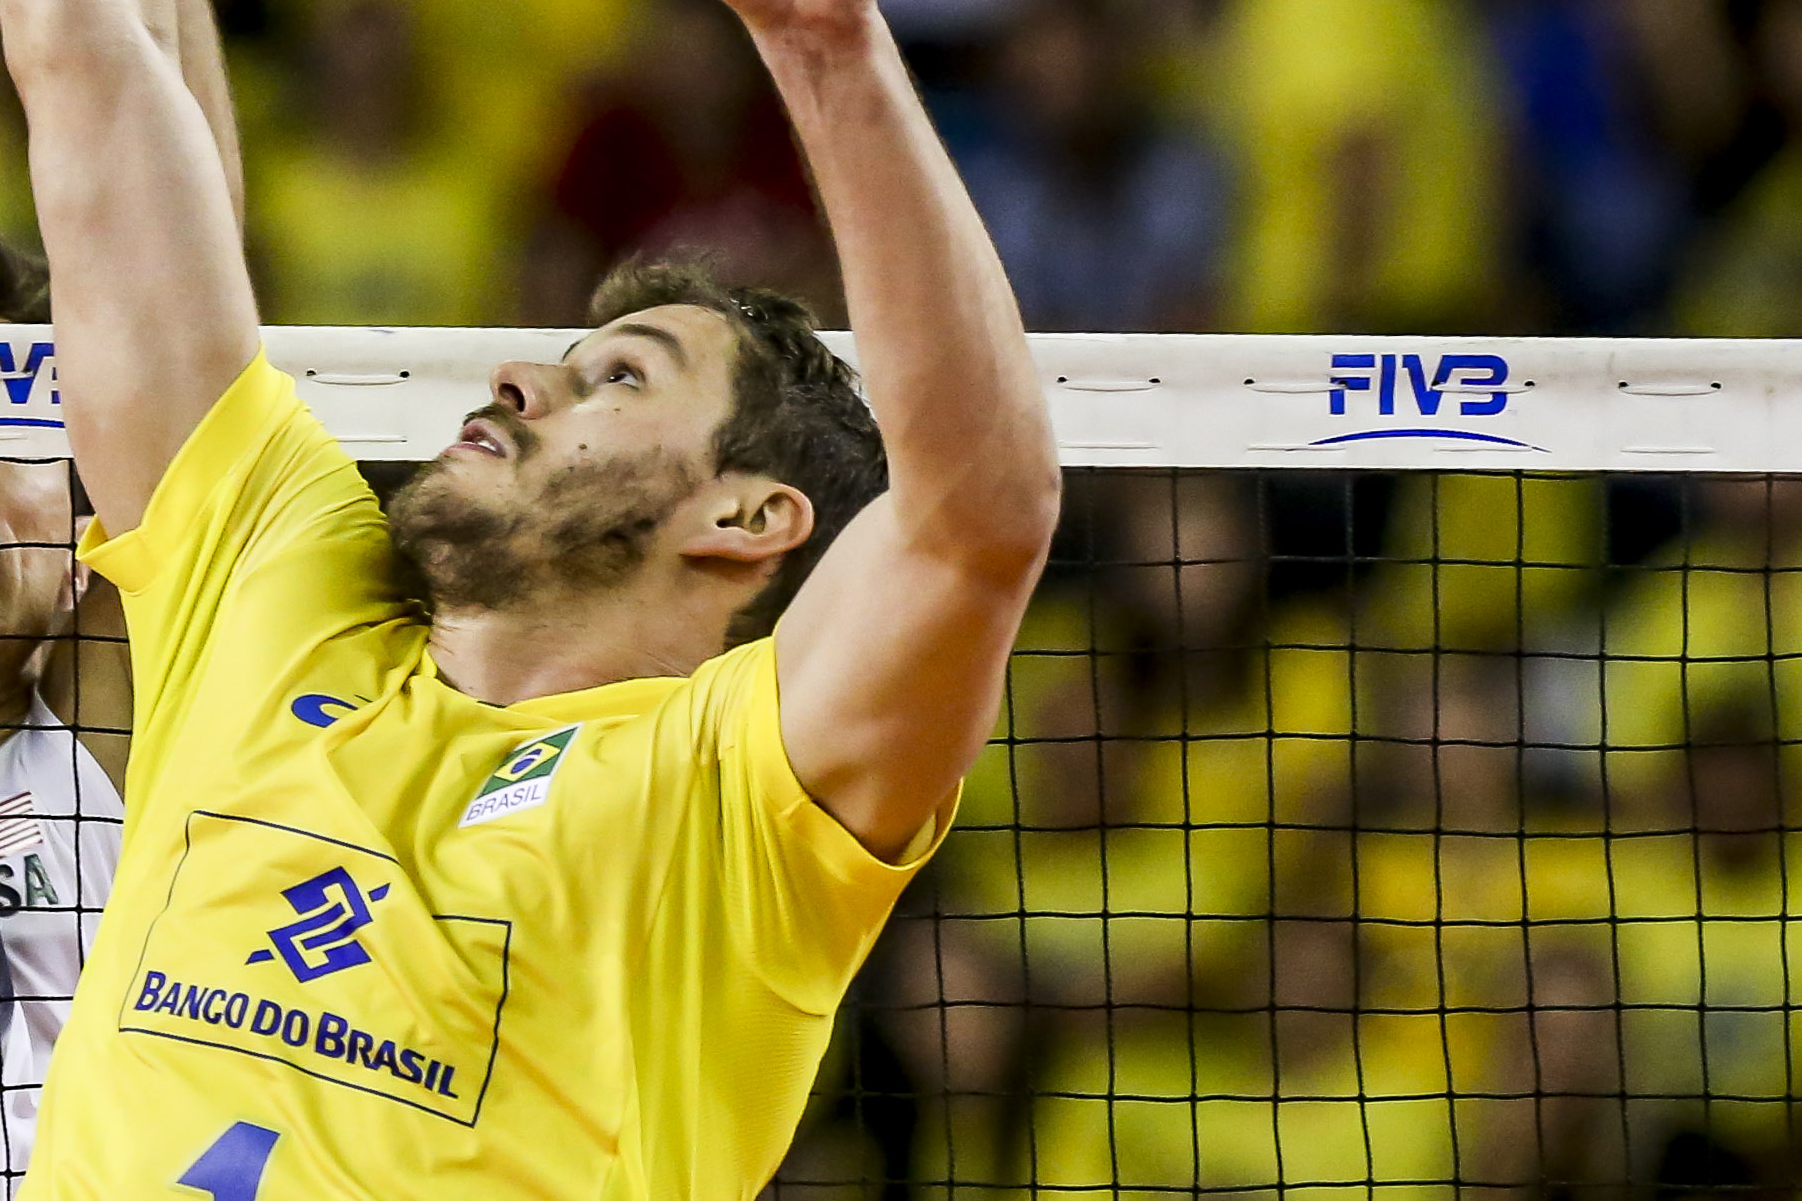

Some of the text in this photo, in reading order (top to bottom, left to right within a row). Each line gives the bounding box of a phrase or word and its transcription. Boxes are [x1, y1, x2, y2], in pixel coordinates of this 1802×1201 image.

[1328, 354, 1508, 416] FIVB
[466, 784, 542, 821] BRASIL
[134, 971, 458, 1099] BANCO DO BRASIL
